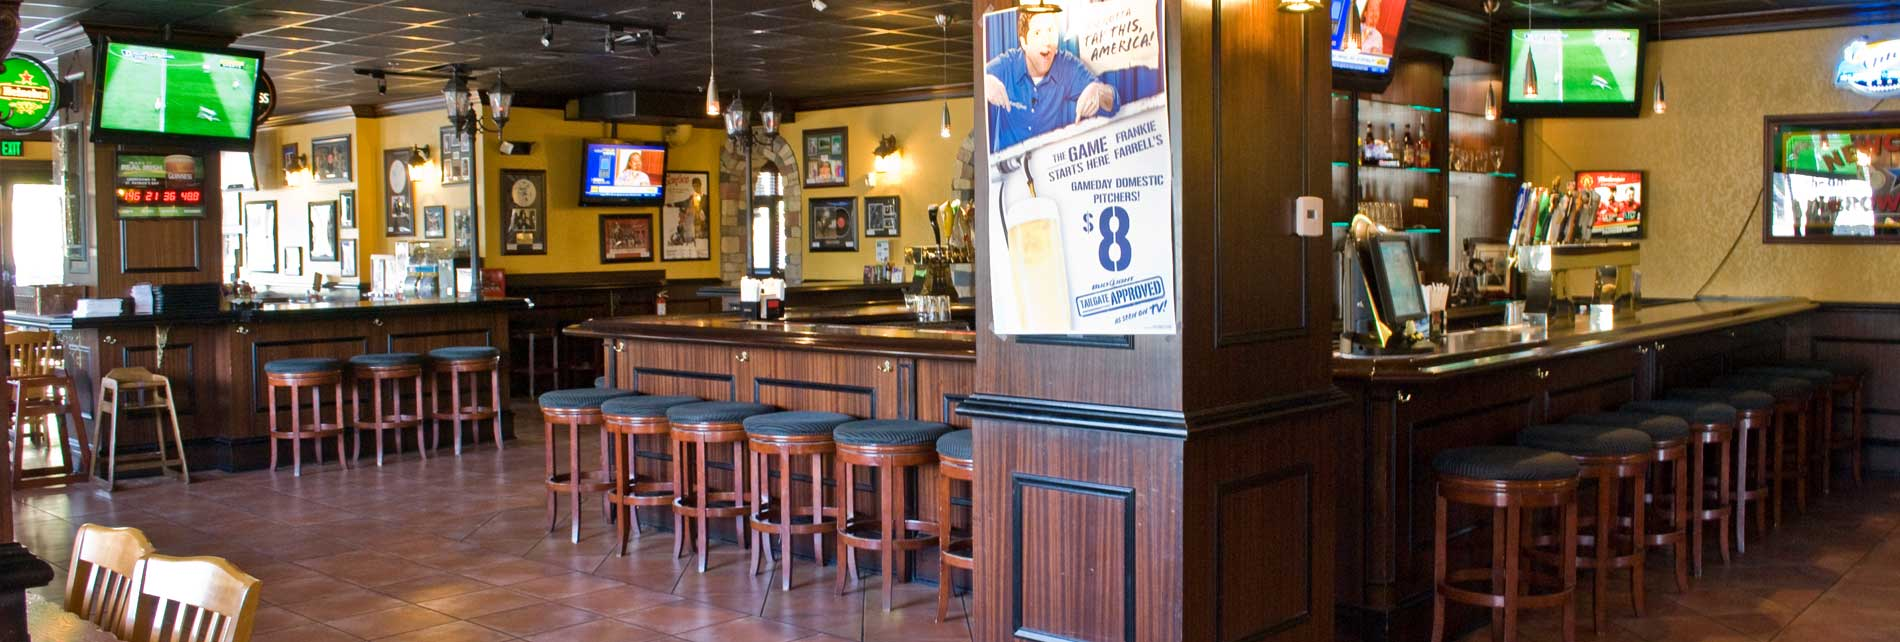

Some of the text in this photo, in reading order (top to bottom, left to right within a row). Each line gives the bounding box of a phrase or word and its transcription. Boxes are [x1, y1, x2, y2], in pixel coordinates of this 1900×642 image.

[1111, 19, 1142, 38] THIS,
[1091, 31, 1154, 62] AMERICA!
[1115, 120, 1157, 143] FRANKIE
[2, 141, 21, 156] EXIT
[1053, 136, 1108, 163] THE GAME
[1114, 134, 1164, 160] FARRELL'S
[1048, 154, 1110, 182] STARTS HERE
[1071, 174, 1164, 192] GAMEDAY DOMESTIC
[1093, 191, 1140, 204] PITCHERS!
[1080, 280, 1161, 309] TAILGATE APPROVED
[1149, 299, 1168, 315] TV!
